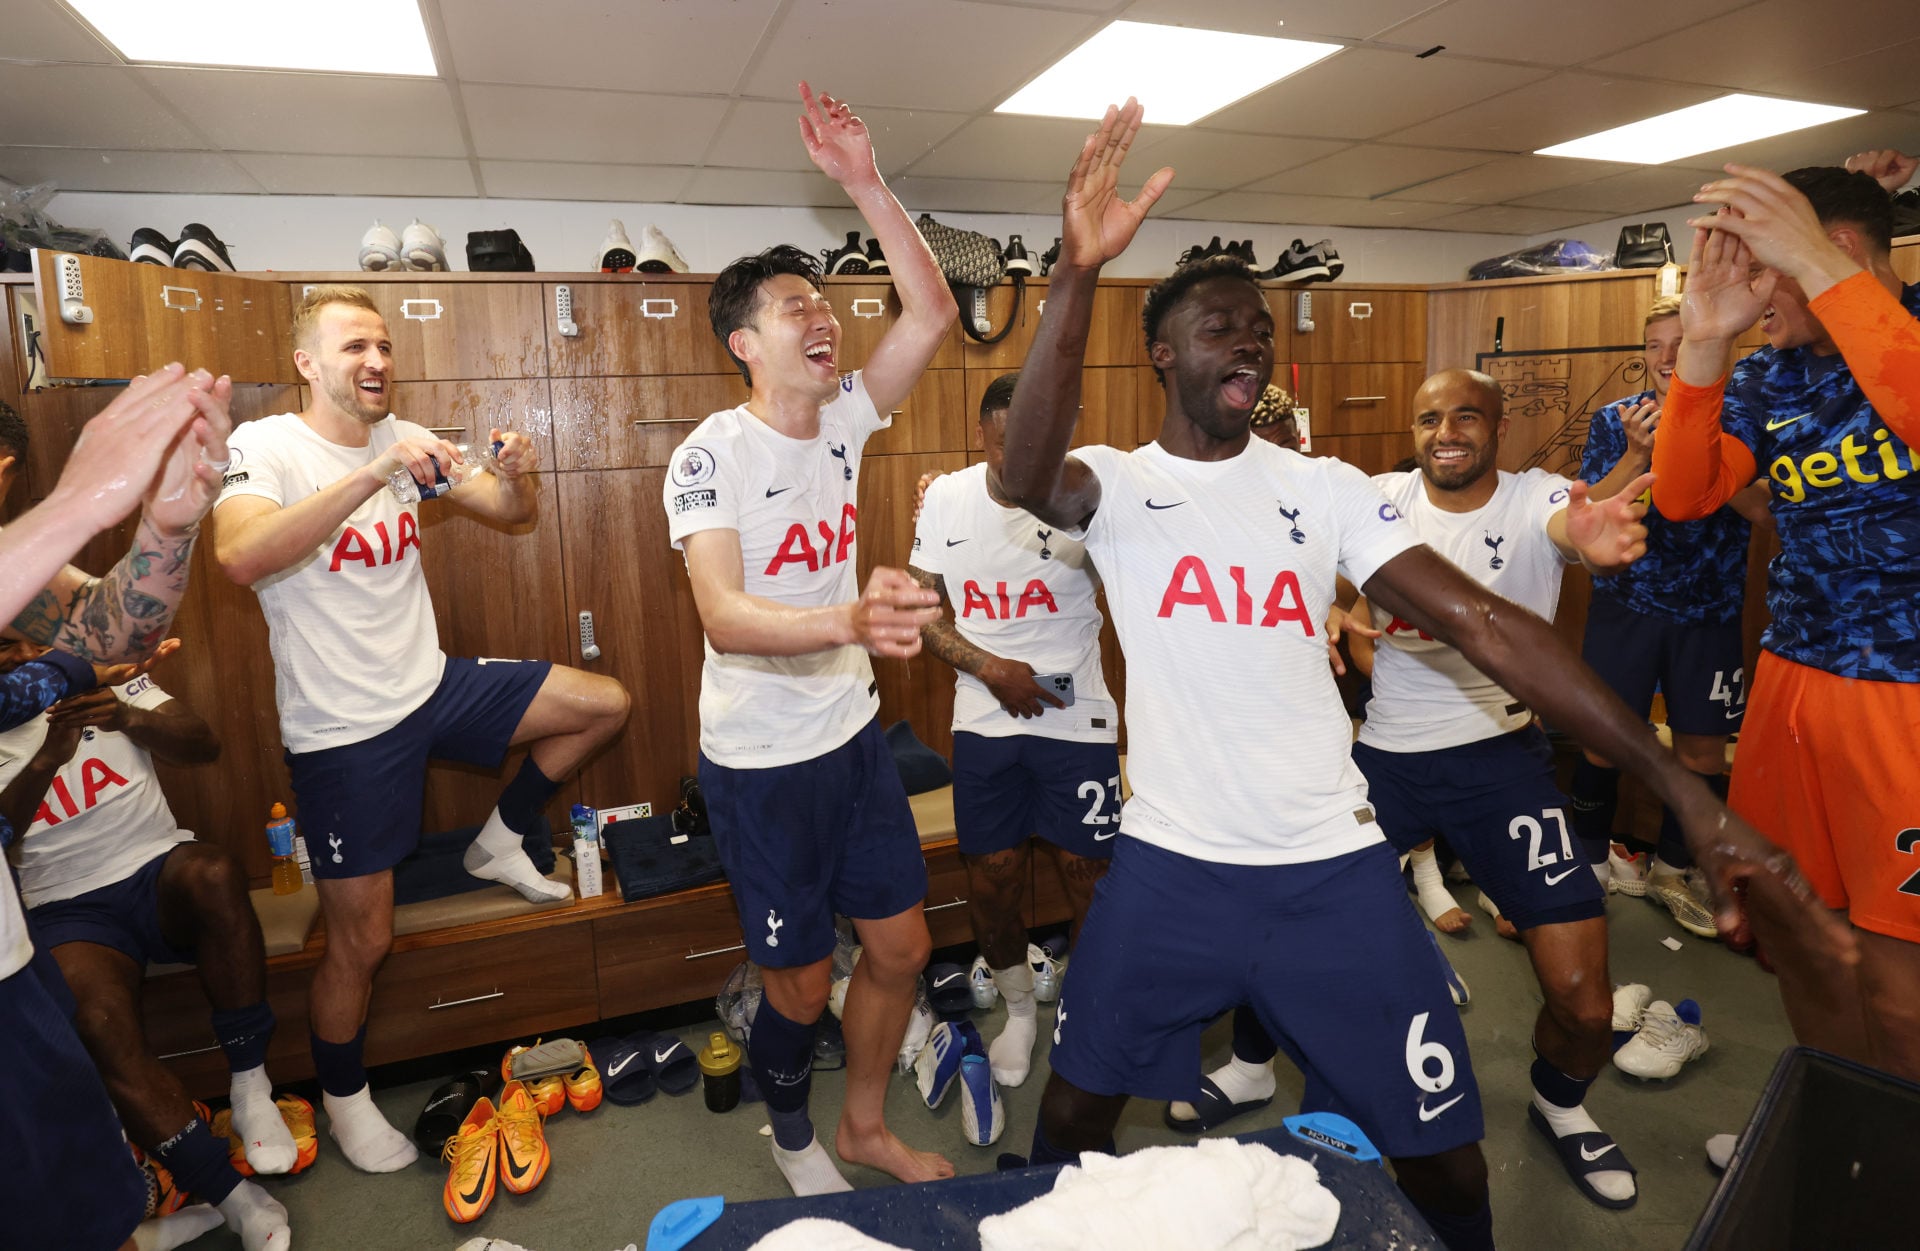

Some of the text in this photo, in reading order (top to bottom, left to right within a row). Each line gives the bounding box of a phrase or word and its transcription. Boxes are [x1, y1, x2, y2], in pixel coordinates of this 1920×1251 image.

[684, 491, 711, 503] room
[1770, 428, 1920, 503] geti
[329, 512, 420, 572] AIA
[764, 503, 857, 575] AIA
[962, 579, 1059, 620] AIA
[1157, 555, 1315, 637] AIA
[1508, 808, 1574, 872] 27
[1405, 1011, 1455, 1093] 6
[1307, 1129, 1348, 1150] MATCH
